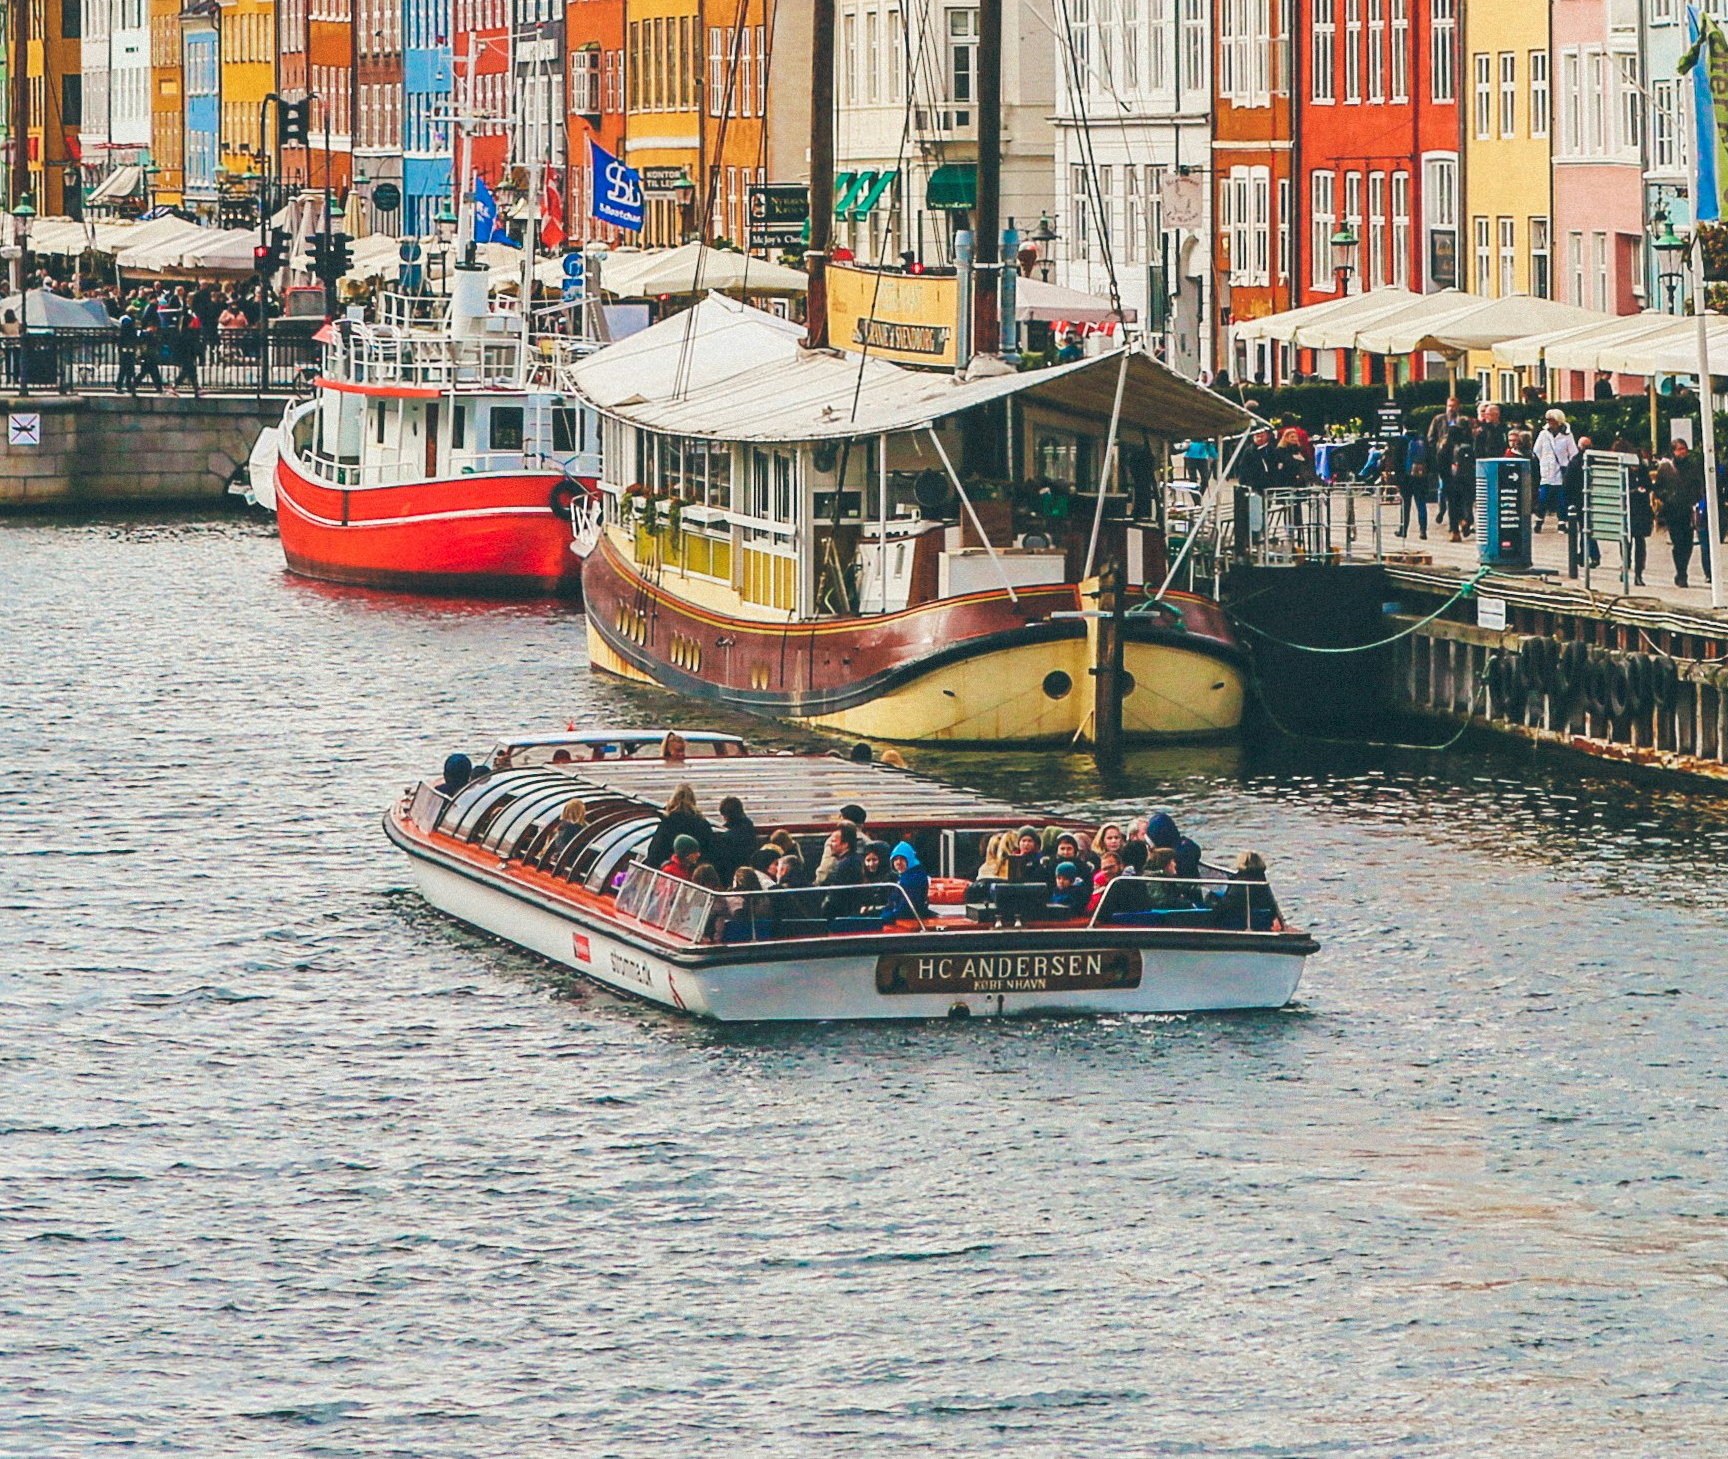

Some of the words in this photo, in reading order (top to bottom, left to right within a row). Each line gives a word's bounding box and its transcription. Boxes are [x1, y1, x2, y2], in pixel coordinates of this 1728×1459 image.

[646, 170, 681, 180] KONTOR
[647, 180, 659, 188] TIL
[961, 954, 1103, 978] ANDERSEN
